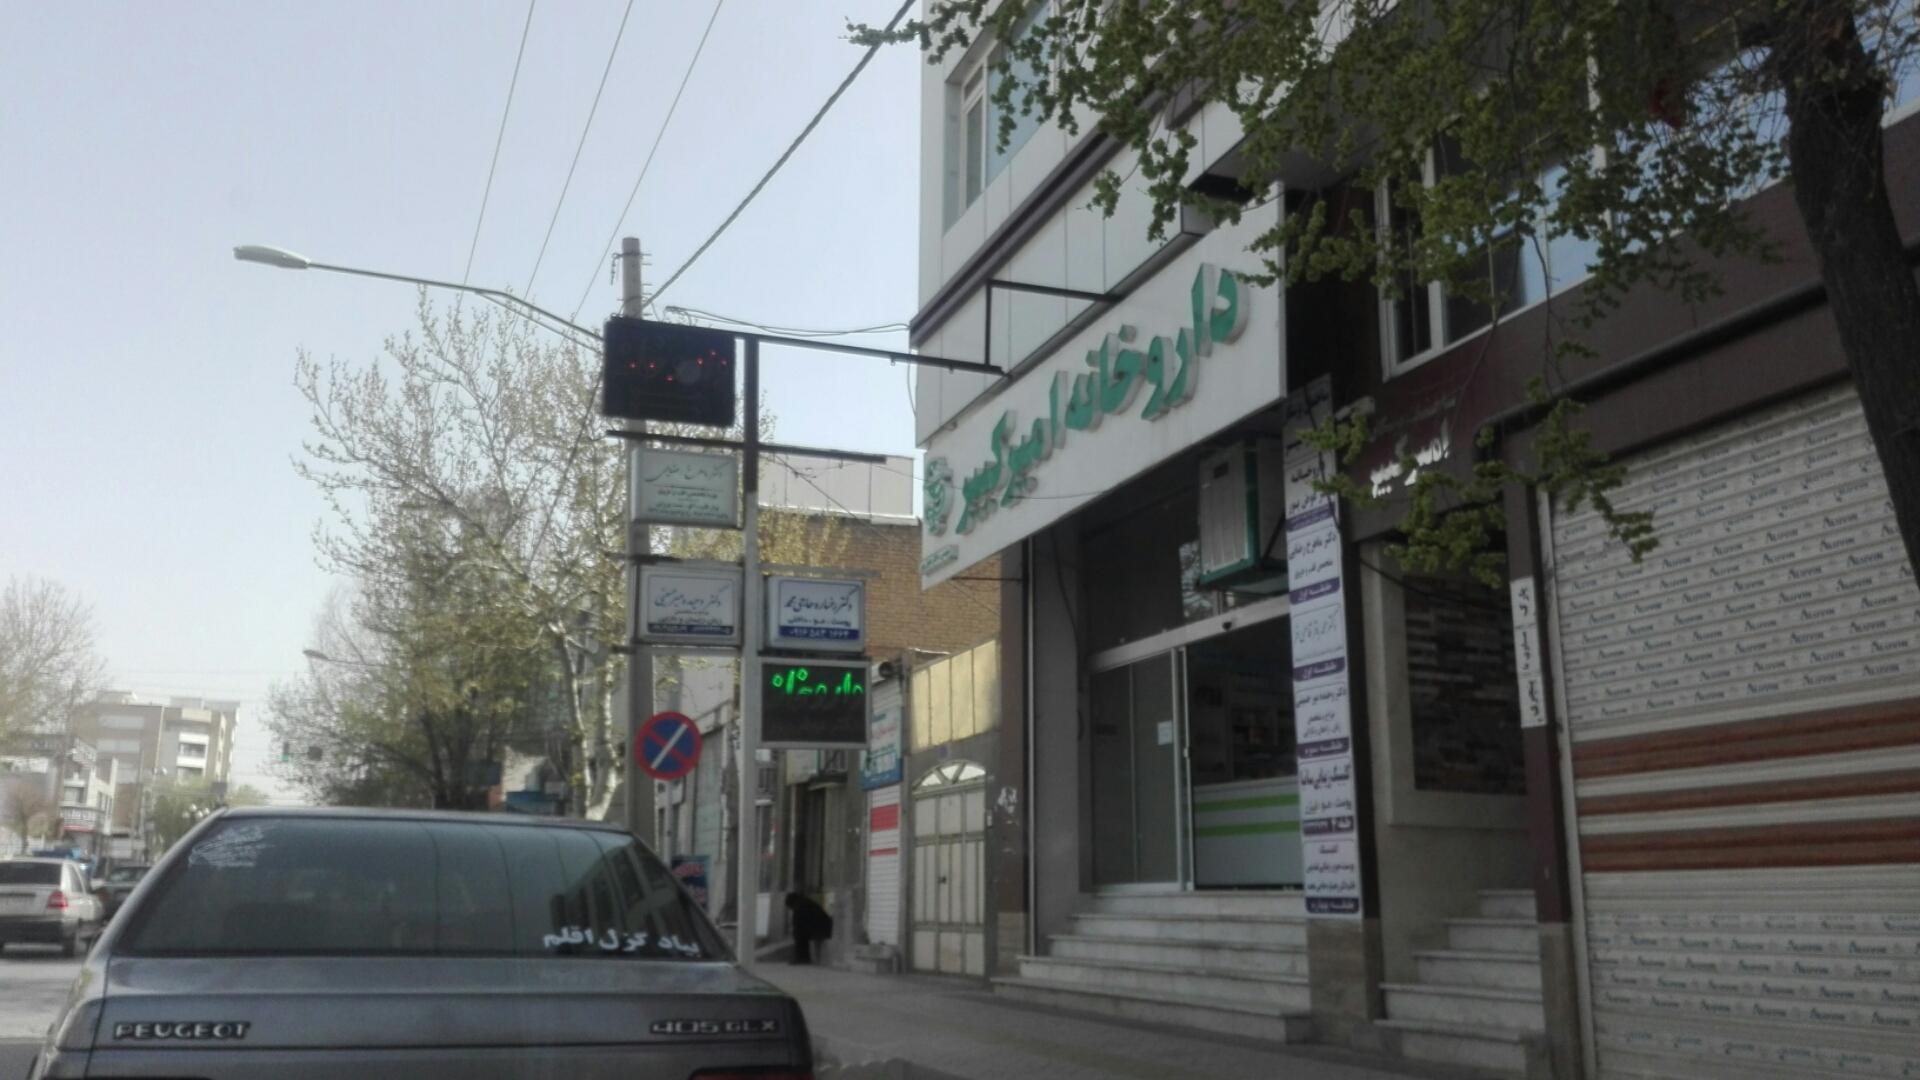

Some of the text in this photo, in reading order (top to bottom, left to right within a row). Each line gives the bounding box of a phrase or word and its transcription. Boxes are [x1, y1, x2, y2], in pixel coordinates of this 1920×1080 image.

[1065, 263, 1248, 430] داروخانه
[114, 1022, 250, 1040] PEUGEOT
[652, 1019, 719, 1033] 405
